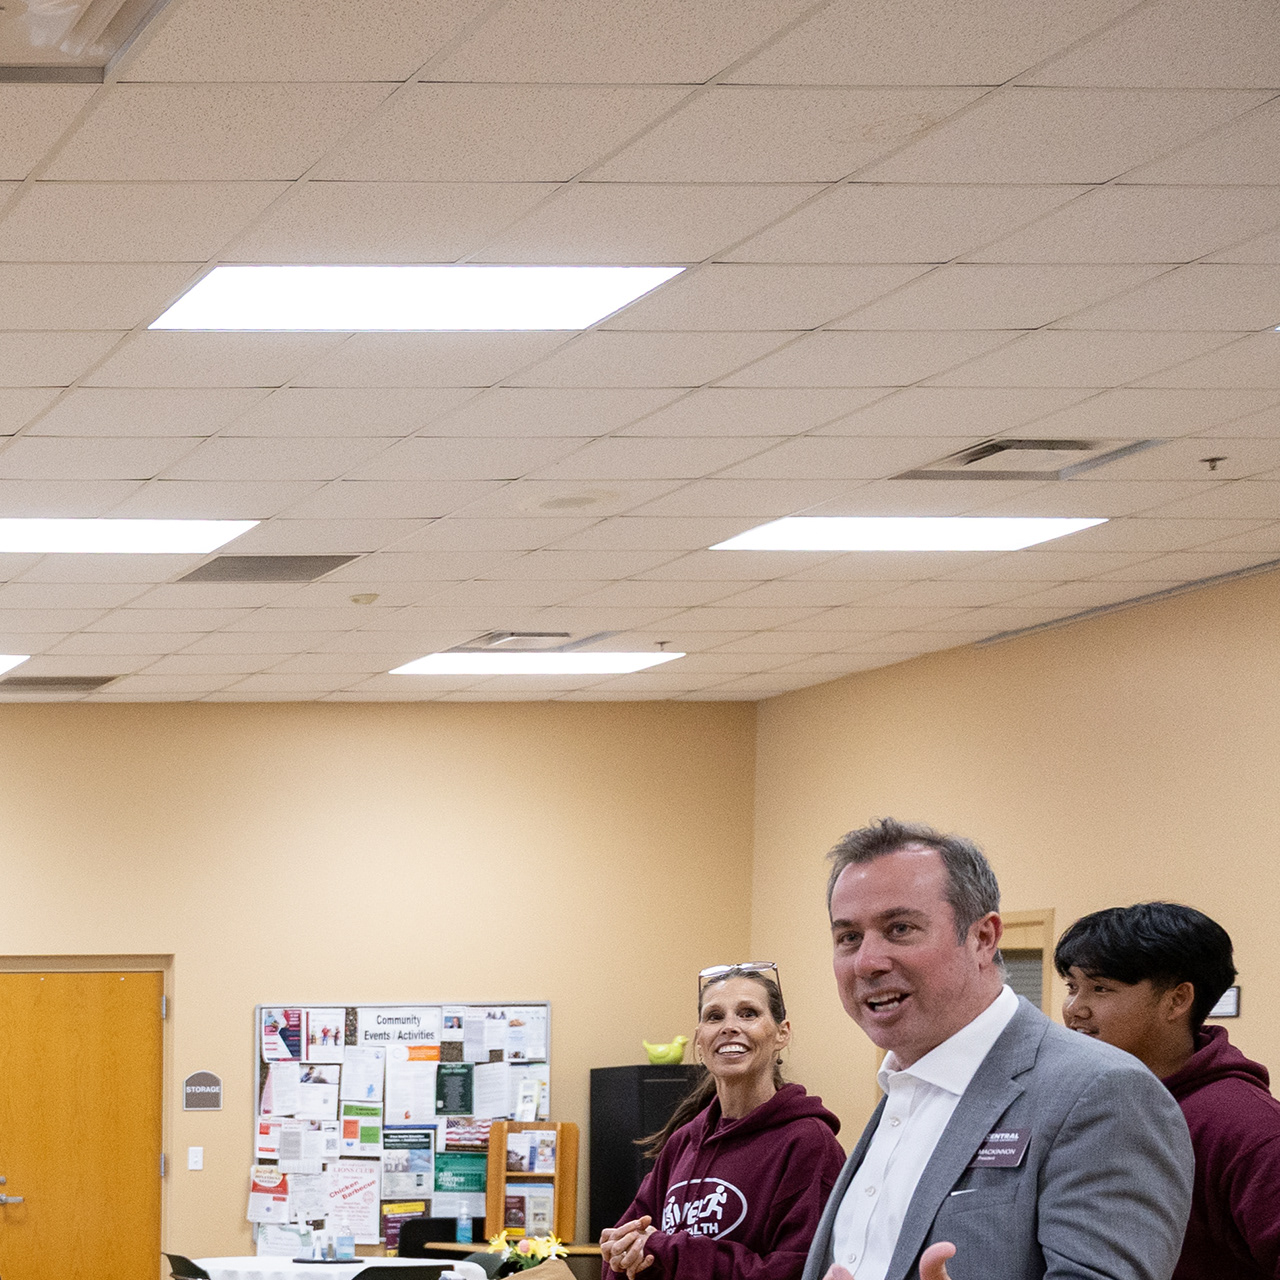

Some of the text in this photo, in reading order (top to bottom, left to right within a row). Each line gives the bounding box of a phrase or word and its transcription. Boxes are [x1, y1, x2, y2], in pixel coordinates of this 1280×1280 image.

[376, 1015, 421, 1027] Community
[364, 1030, 390, 1040] Events
[397, 1030, 434, 1040] Activities
[329, 1180, 359, 1198] Chicken
[342, 1180, 376, 1200] Barbecue
